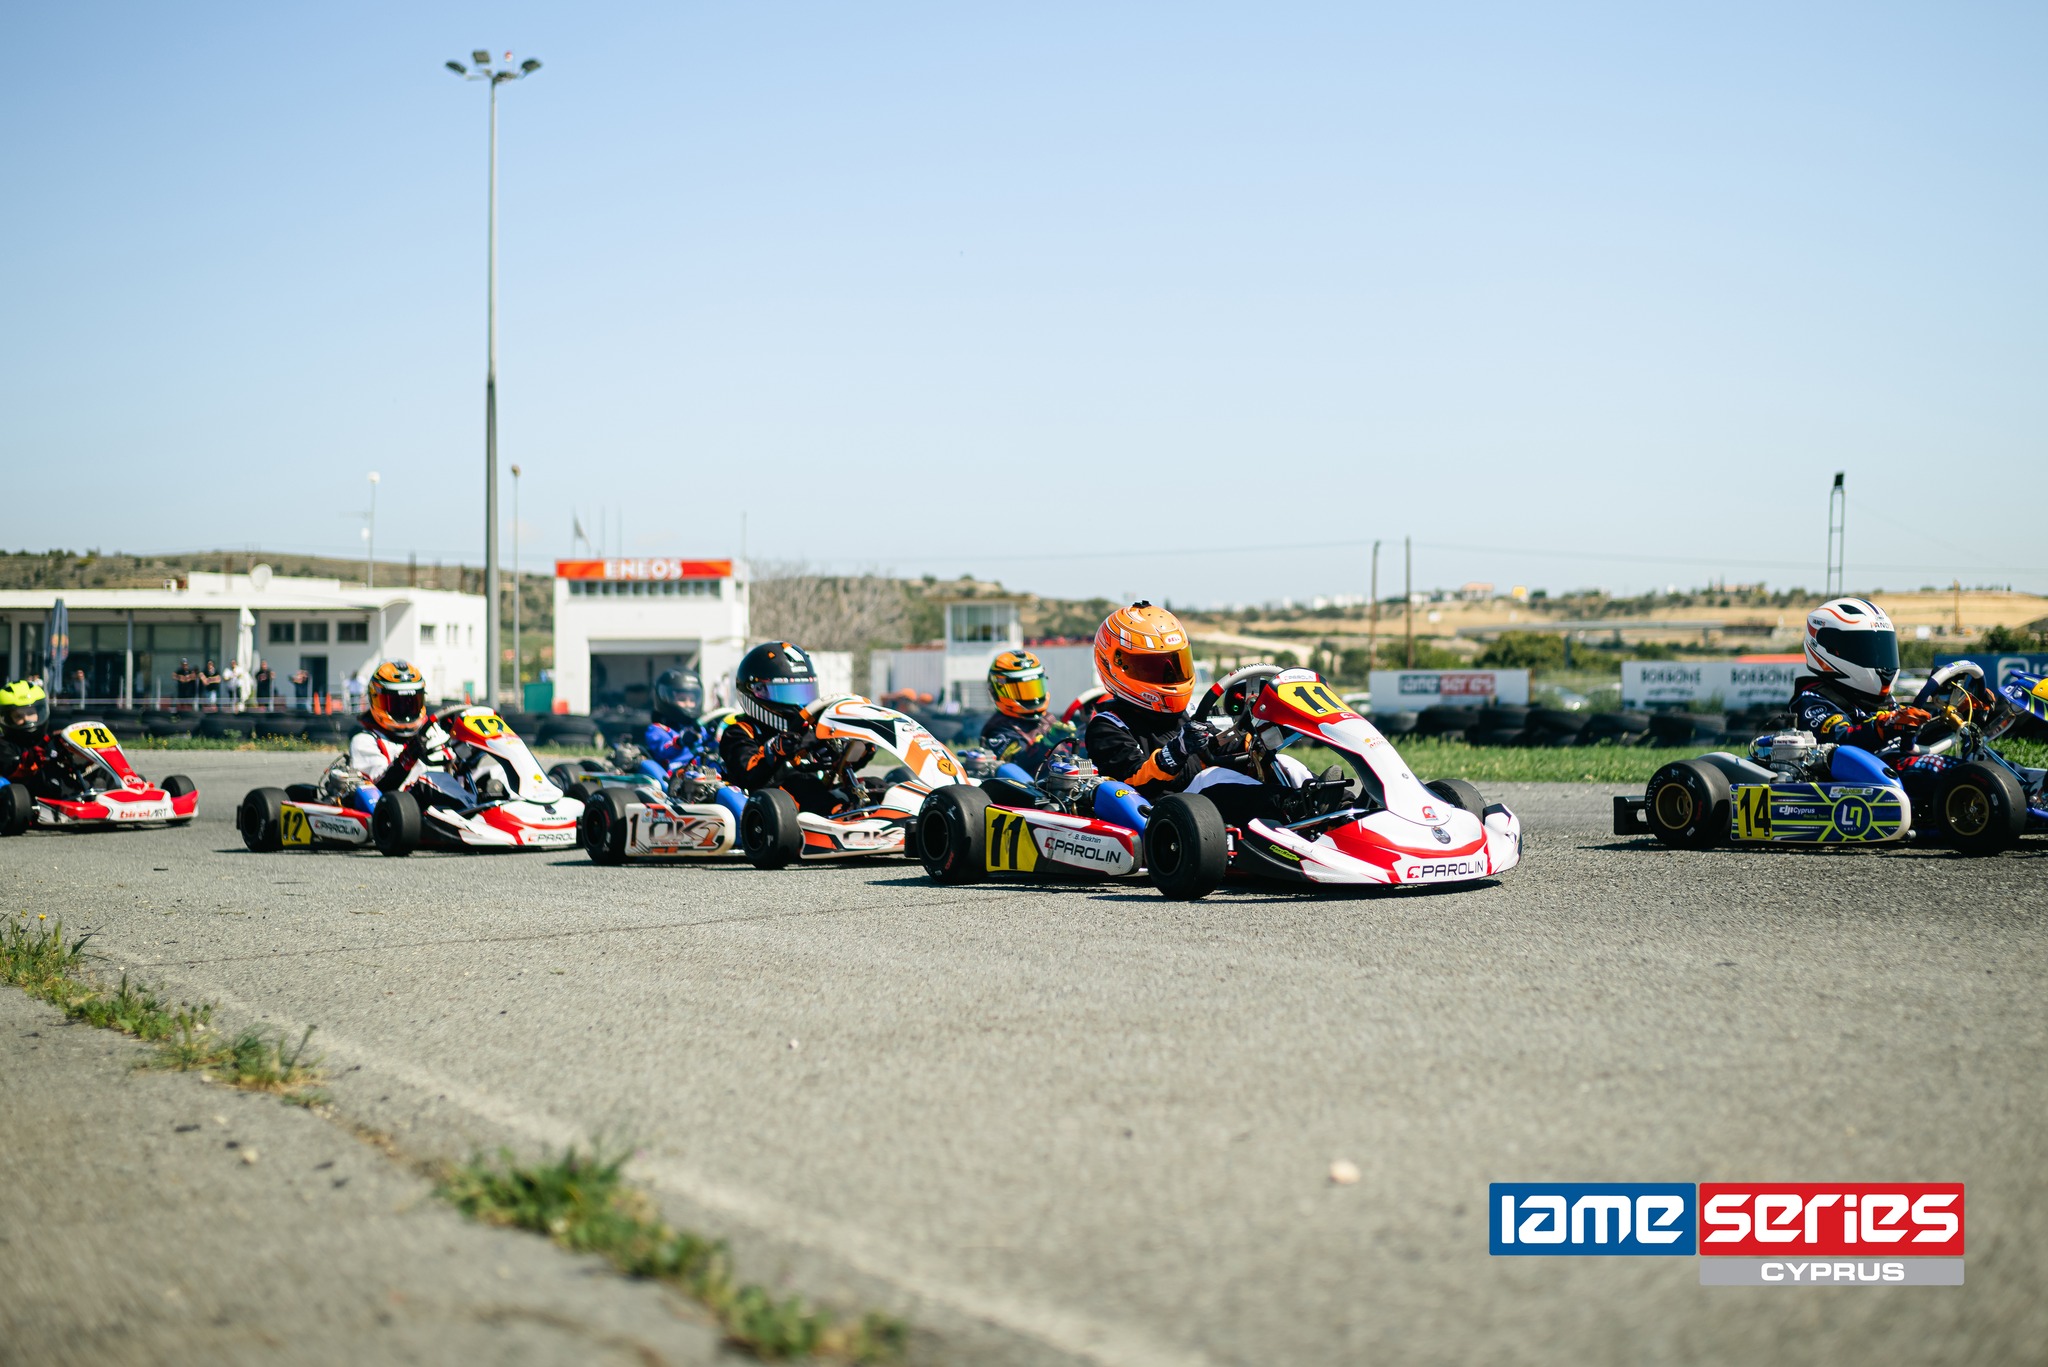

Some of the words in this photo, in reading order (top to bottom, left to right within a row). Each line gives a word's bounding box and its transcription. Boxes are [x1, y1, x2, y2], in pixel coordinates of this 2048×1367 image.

[605, 559, 683, 580] ENEOS
[1641, 667, 1702, 685] BORBONE
[1142, 692, 1158, 702] BELL
[1293, 686, 1346, 714] 11
[79, 728, 110, 745] 28
[1740, 787, 1771, 837] 14
[283, 810, 303, 842] 12
[630, 813, 639, 847] 1
[991, 814, 1024, 870] 11
[1081, 834, 1102, 844] Blokhin
[1054, 839, 1122, 864] PAROLIN
[1421, 860, 1484, 878] PAROLIN
